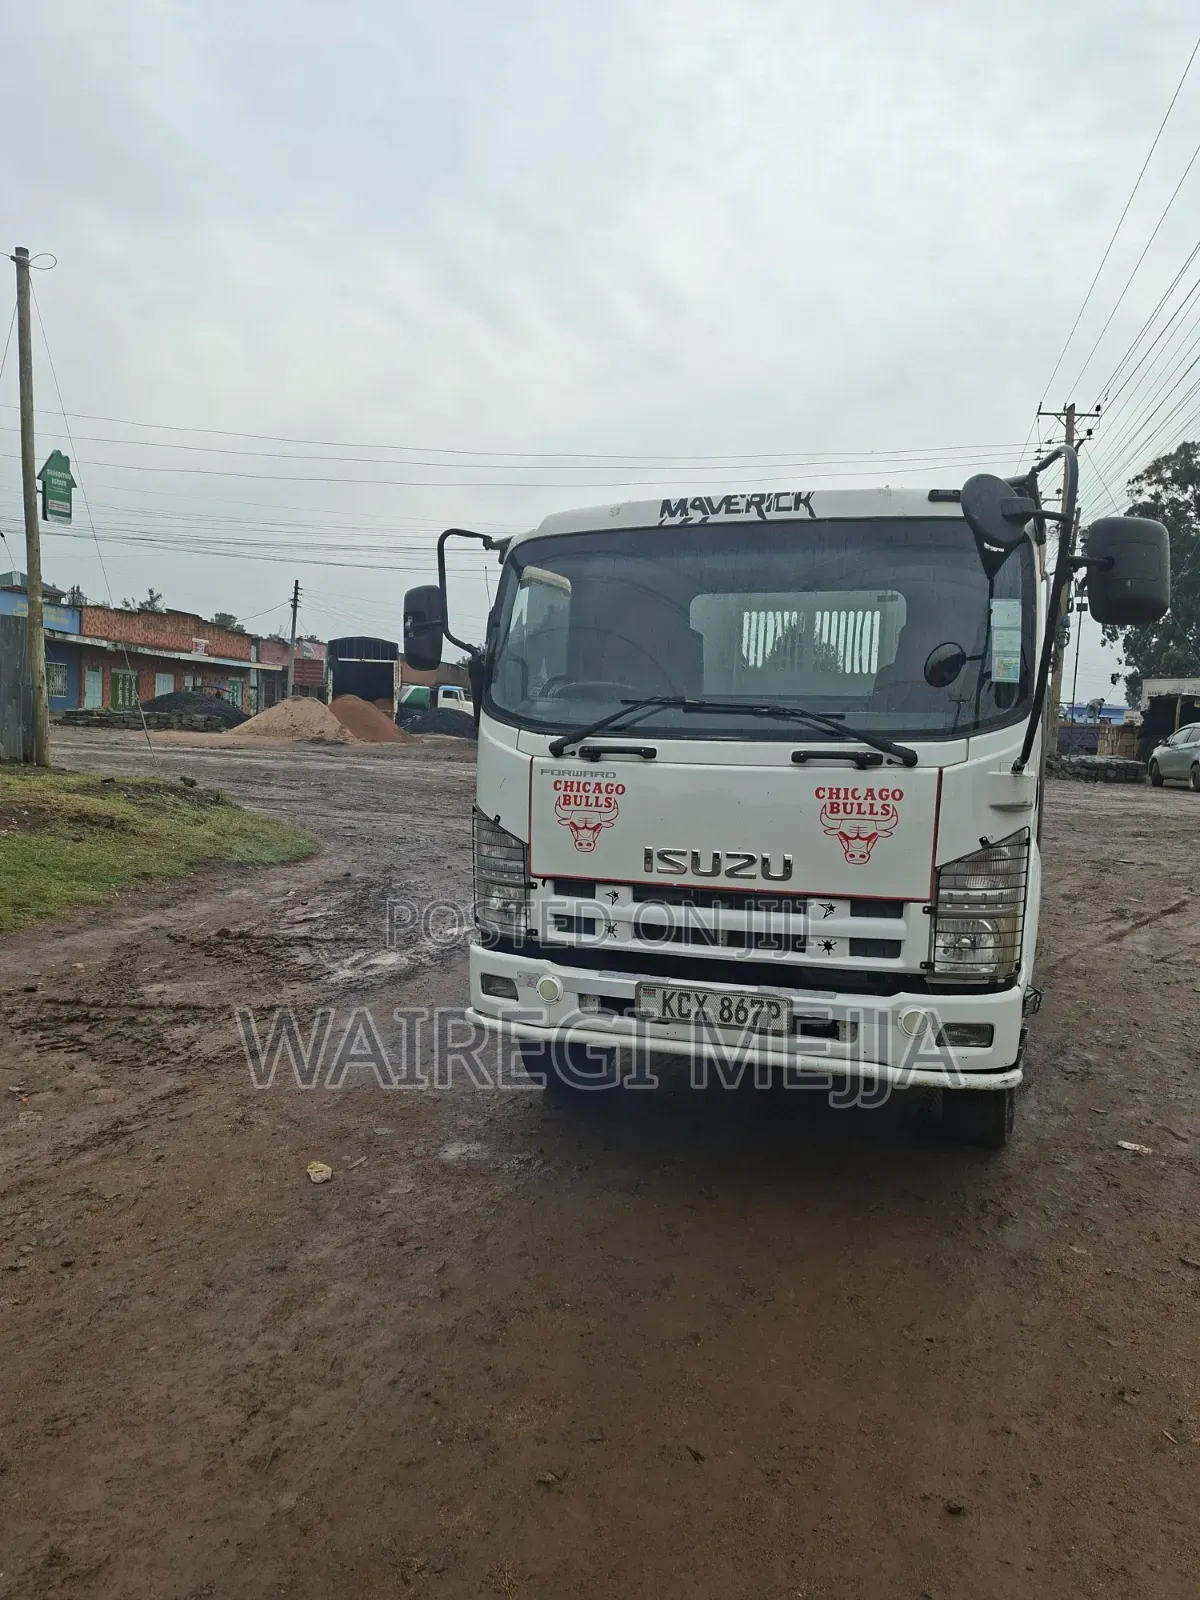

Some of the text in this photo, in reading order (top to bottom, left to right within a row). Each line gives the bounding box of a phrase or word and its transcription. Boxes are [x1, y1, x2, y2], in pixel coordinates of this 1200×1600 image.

[658, 491, 816, 525] MAVERICK
[540, 769, 617, 779] FORWARD
[553, 780, 626, 796] CHICAGO
[814, 786, 905, 801] CHICAGO
[562, 794, 613, 809] BULLS
[829, 801, 891, 816] BULLS
[643, 846, 794, 882] ISUZU
[661, 990, 708, 1021] KCX
